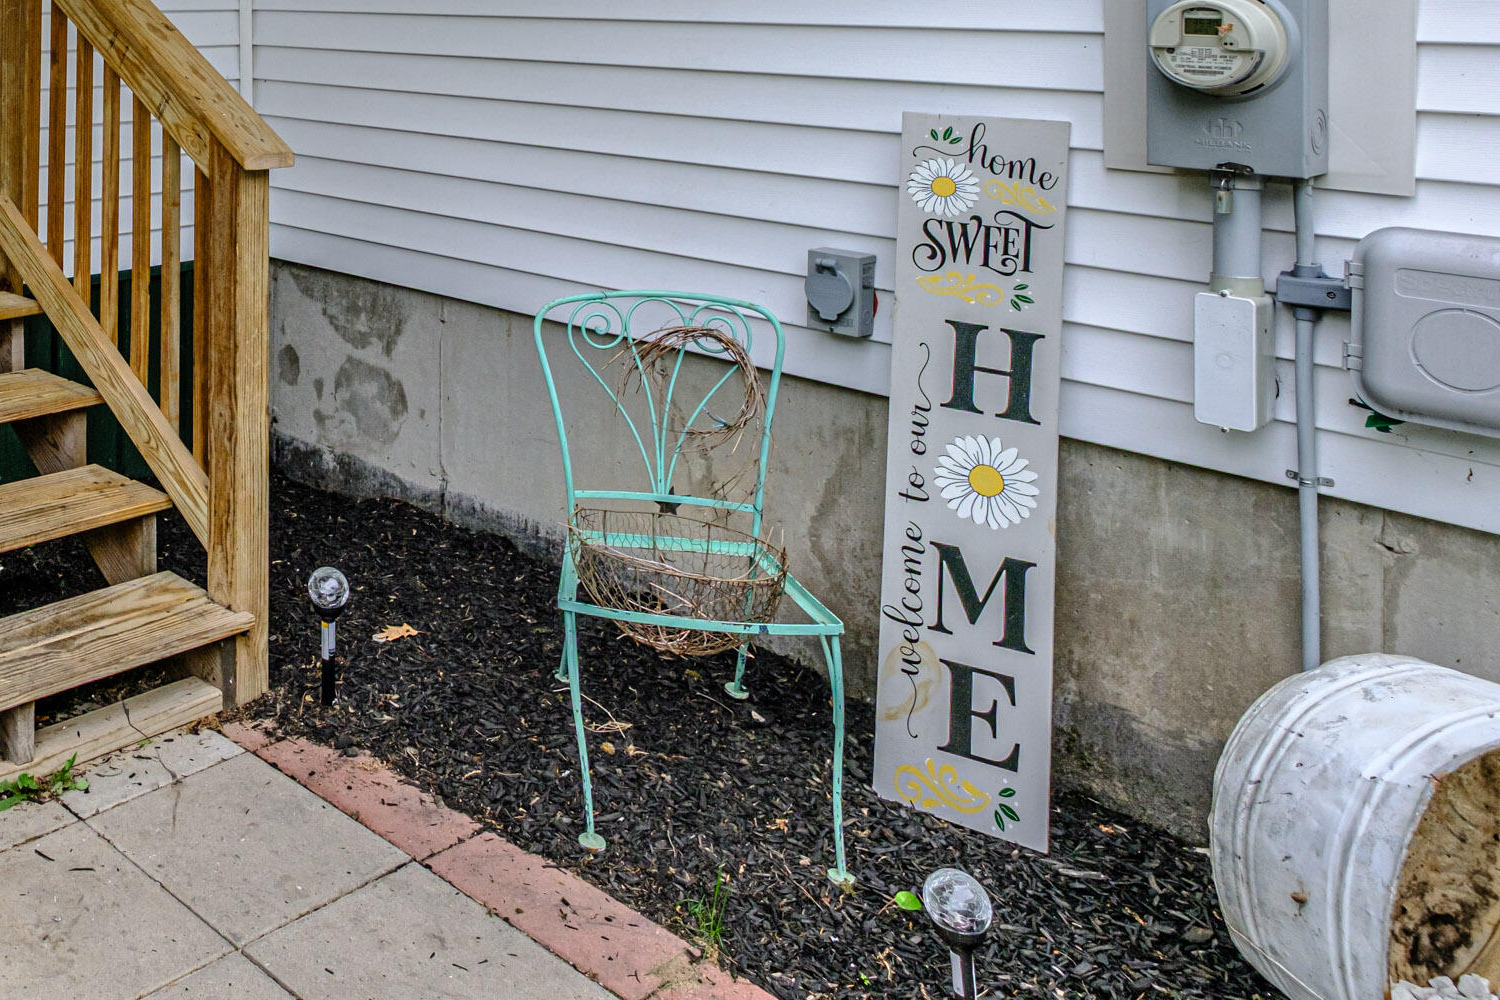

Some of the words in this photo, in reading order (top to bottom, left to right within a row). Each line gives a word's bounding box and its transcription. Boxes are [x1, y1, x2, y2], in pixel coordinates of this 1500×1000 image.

[913, 122, 1059, 191] home
[912, 210, 1055, 276] SWEET
[898, 465, 930, 503] to
[882, 520, 926, 739] welcome
